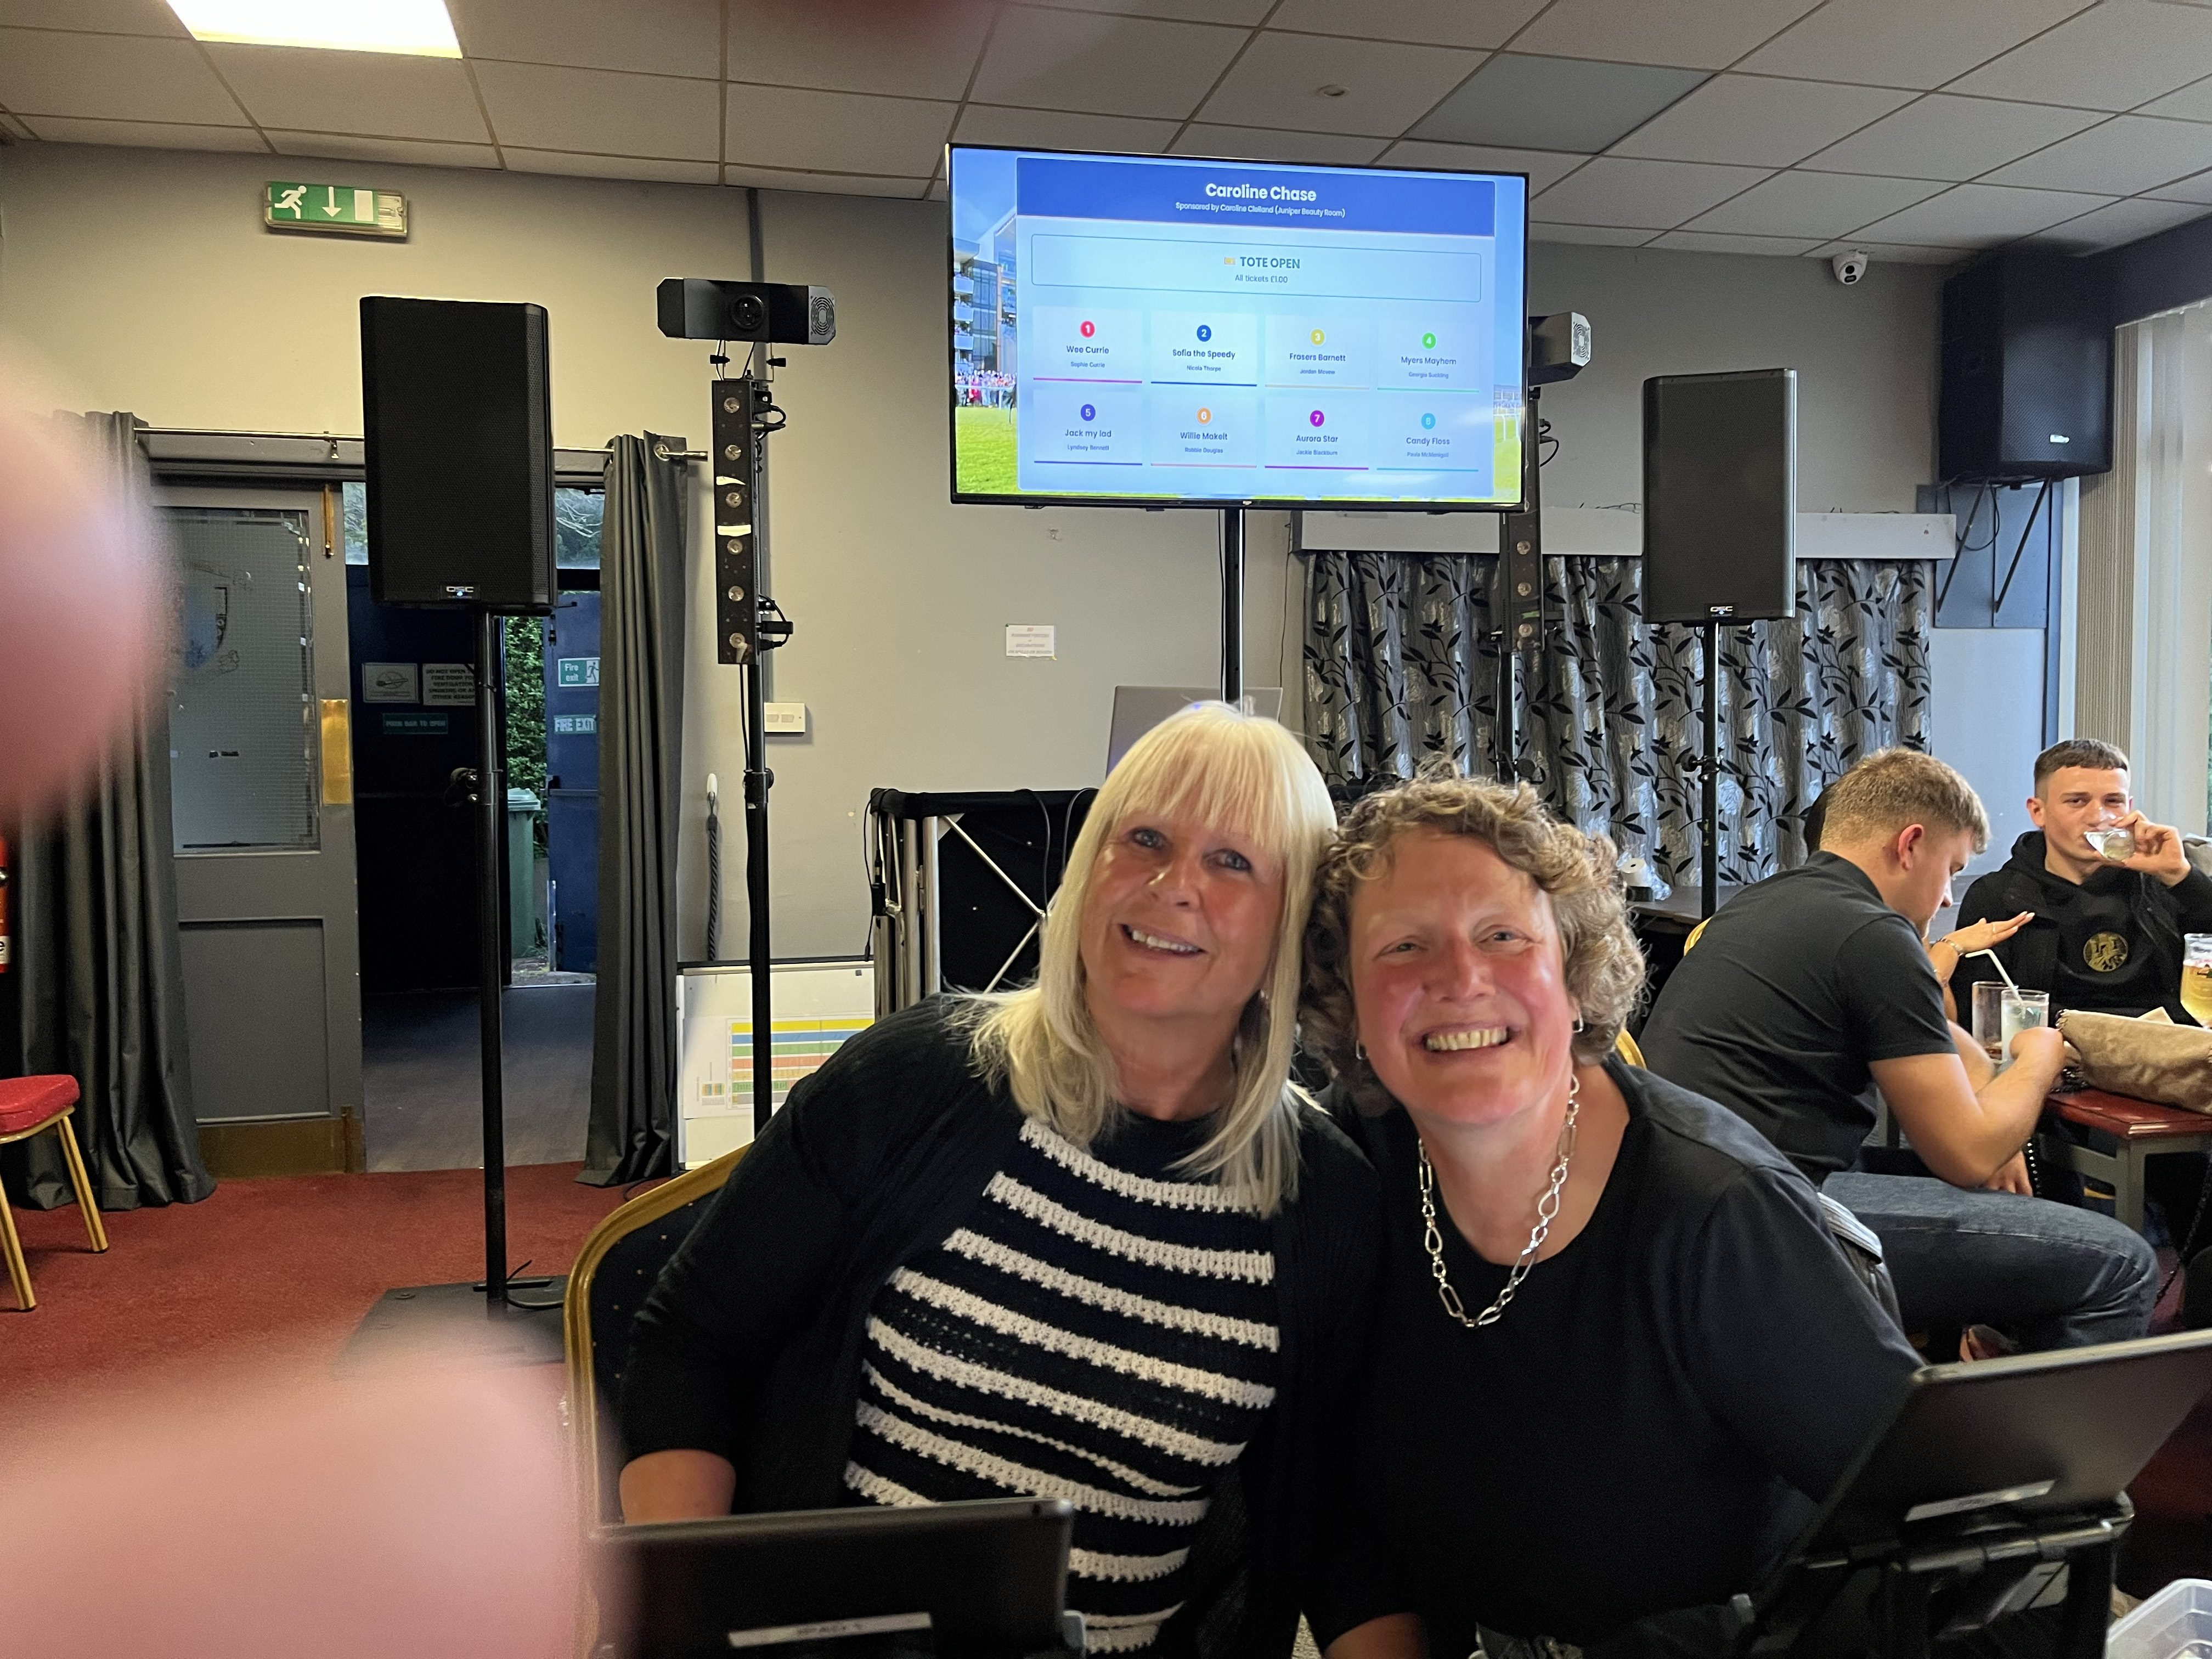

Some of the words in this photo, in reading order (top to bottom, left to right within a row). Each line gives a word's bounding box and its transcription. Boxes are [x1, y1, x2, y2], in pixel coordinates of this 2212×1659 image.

[1206, 183, 1268, 199] Caroline
[1270, 186, 1316, 201] Chase
[1176, 202, 1210, 211] Sponsored
[1211, 204, 1220, 213] by
[1275, 205, 1301, 216] (Juniper
[1301, 208, 1324, 218] Beauty
[1324, 208, 1346, 218] Room)
[1240, 257, 1268, 268] TOTE
[1270, 258, 1300, 269] OPEN
[1085, 324, 1090, 334] 1
[1201, 329, 1207, 337] 2
[1315, 332, 1321, 341] 3
[1426, 336, 1431, 345] 4
[1066, 345, 1084, 353] Wee
[1207, 350, 1235, 360] Speedy
[1401, 356, 1423, 365] Myers
[1425, 357, 1457, 366] Mayhem
[1085, 408, 1091, 417] 5
[1201, 411, 1207, 420] 6
[1314, 414, 1321, 423] 7
[1426, 417, 1431, 425] 8
[1085, 431, 1098, 439] my
[1406, 437, 1431, 447] Candy
[565, 663, 579, 672] Fire
[566, 673, 579, 682] exit
[555, 718, 573, 732] FIRE
[575, 718, 595, 731] EXIT
